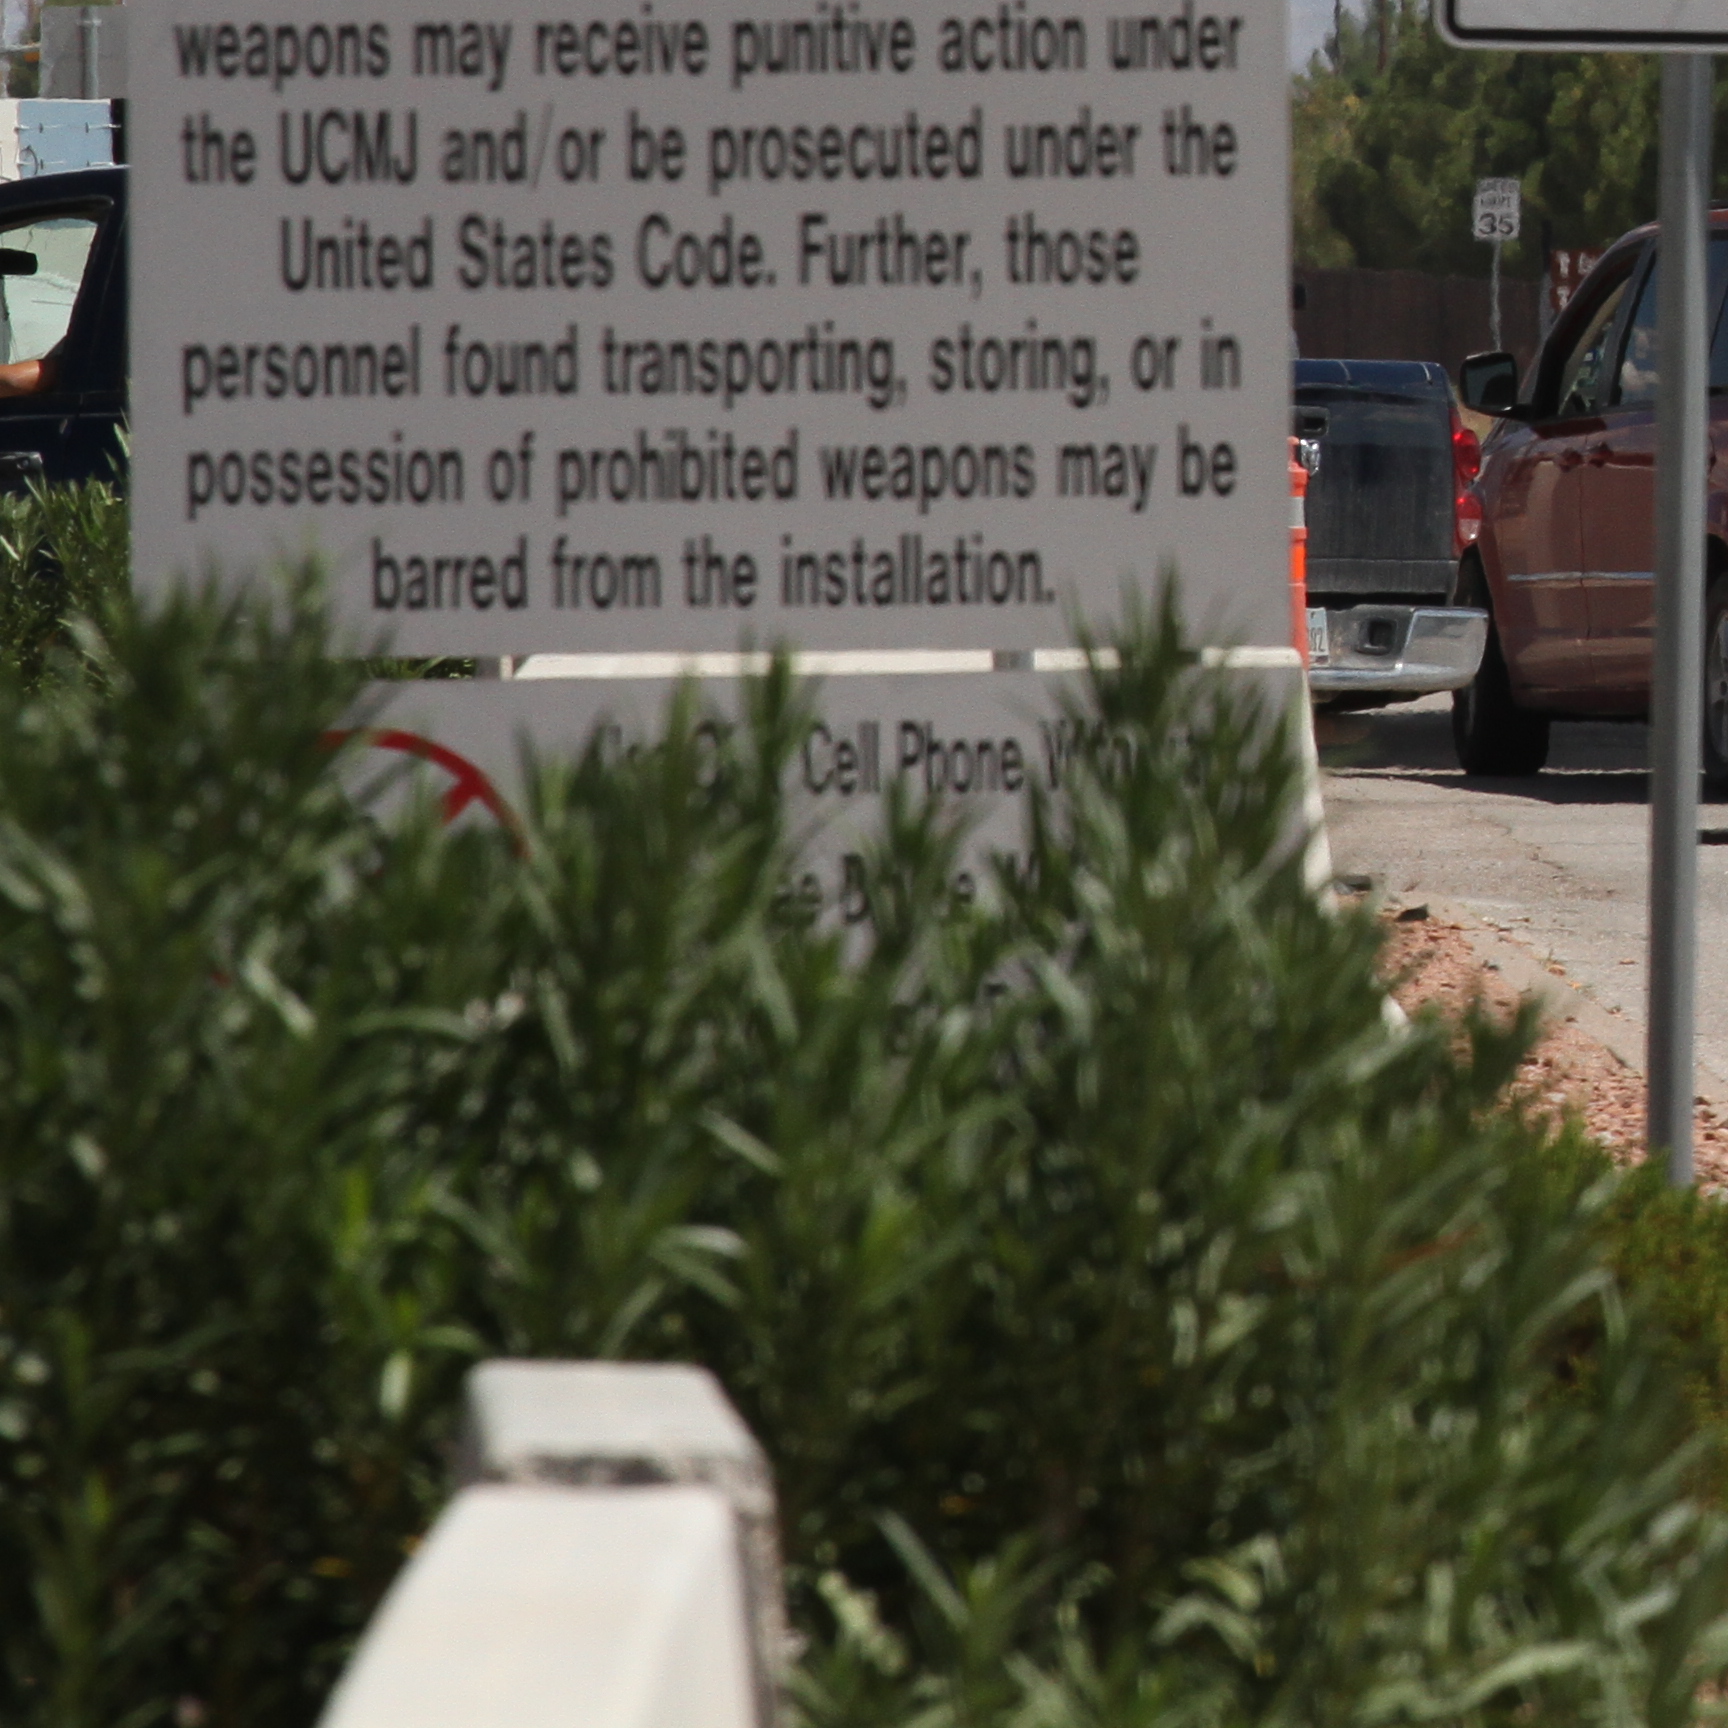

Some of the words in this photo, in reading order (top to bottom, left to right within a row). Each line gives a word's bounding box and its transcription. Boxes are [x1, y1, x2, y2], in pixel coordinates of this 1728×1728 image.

[172, 21, 391, 91] weapons
[412, 20, 513, 91] may
[534, 3, 710, 78] receive
[730, 1, 916, 90] punitive
[937, 0, 1086, 74] action
[179, 112, 258, 187] the
[278, 106, 418, 187] UCMJ
[439, 110, 612, 190] and/or
[627, 110, 687, 184] be
[707, 107, 983, 197] prosecuted
[1005, 106, 1141, 180] under
[1161, 105, 1238, 179] the
[279, 216, 435, 294] United
[456, 212, 615, 292] States
[635, 211, 777, 291] Code.
[798, 211, 983, 298] Further,
[1004, 212, 1140, 286] those
[180, 323, 421, 415] personnel
[442, 323, 579, 399] found
[599, 320, 907, 413] transporting,
[929, 320, 1109, 410] storing,
[1130, 335, 1180, 392] or
[1200, 318, 1241, 390] in
[185, 429, 465, 523] possession
[485, 430, 536, 504] of
[555, 428, 799, 518] prohibited
[818, 443, 1036, 515] weapons
[1057, 442, 1157, 514] may
[1176, 424, 1238, 498] be
[370, 534, 529, 613] barred
[549, 534, 662, 611] from
[681, 535, 758, 609] the
[781, 534, 1055, 608] installation.
[802, 720, 882, 795] Cell
[899, 720, 1024, 793] Phone
